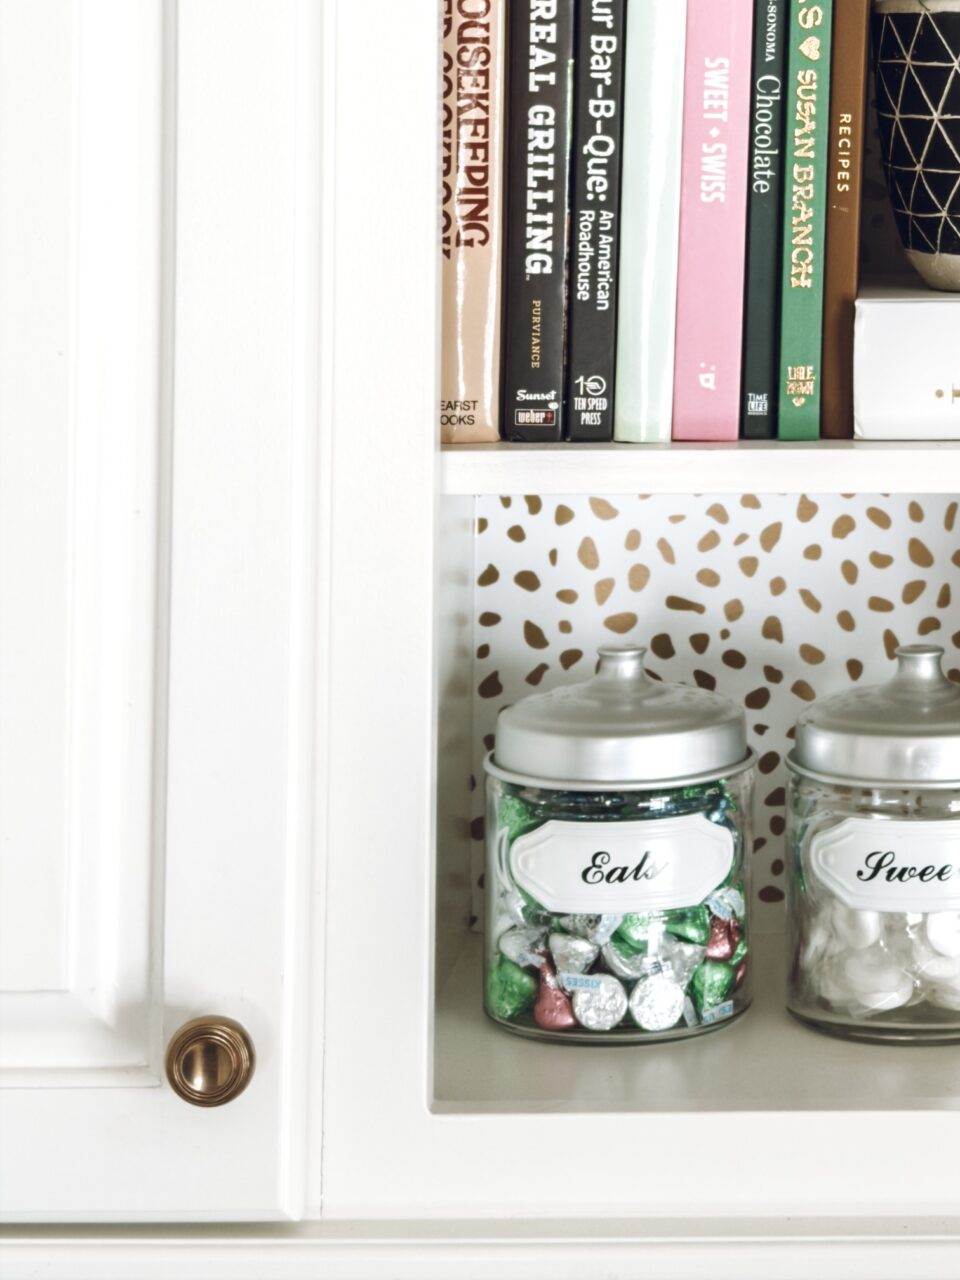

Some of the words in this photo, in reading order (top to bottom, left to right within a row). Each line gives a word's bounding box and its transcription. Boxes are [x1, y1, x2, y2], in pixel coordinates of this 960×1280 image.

[704, 56, 732, 122] SWEET
[581, 34, 619, 203] Bar-B-Que:
[753, 73, 781, 194] Chocolate
[792, 68, 820, 160] SUSAN
[700, 141, 728, 204] SWISS
[836, 112, 851, 194] RECIPES
[598, 209, 615, 232] An
[789, 163, 816, 290] BRANCH
[576, 209, 596, 302] Roadhouse
[595, 232, 614, 311] American
[530, 299, 542, 369] PURVIANCE
[440, 400, 479, 411] EARST
[516, 389, 557, 402] Sunset
[518, 410, 546, 424] weber
[573, 397, 587, 411] TEN
[587, 397, 608, 411] SPEED
[580, 412, 602, 425] PRESS
[747, 392, 769, 401] TIME
[748, 401, 768, 412] LIFE
[440, 414, 476, 426] OOKS
[580, 851, 669, 884] Eats
